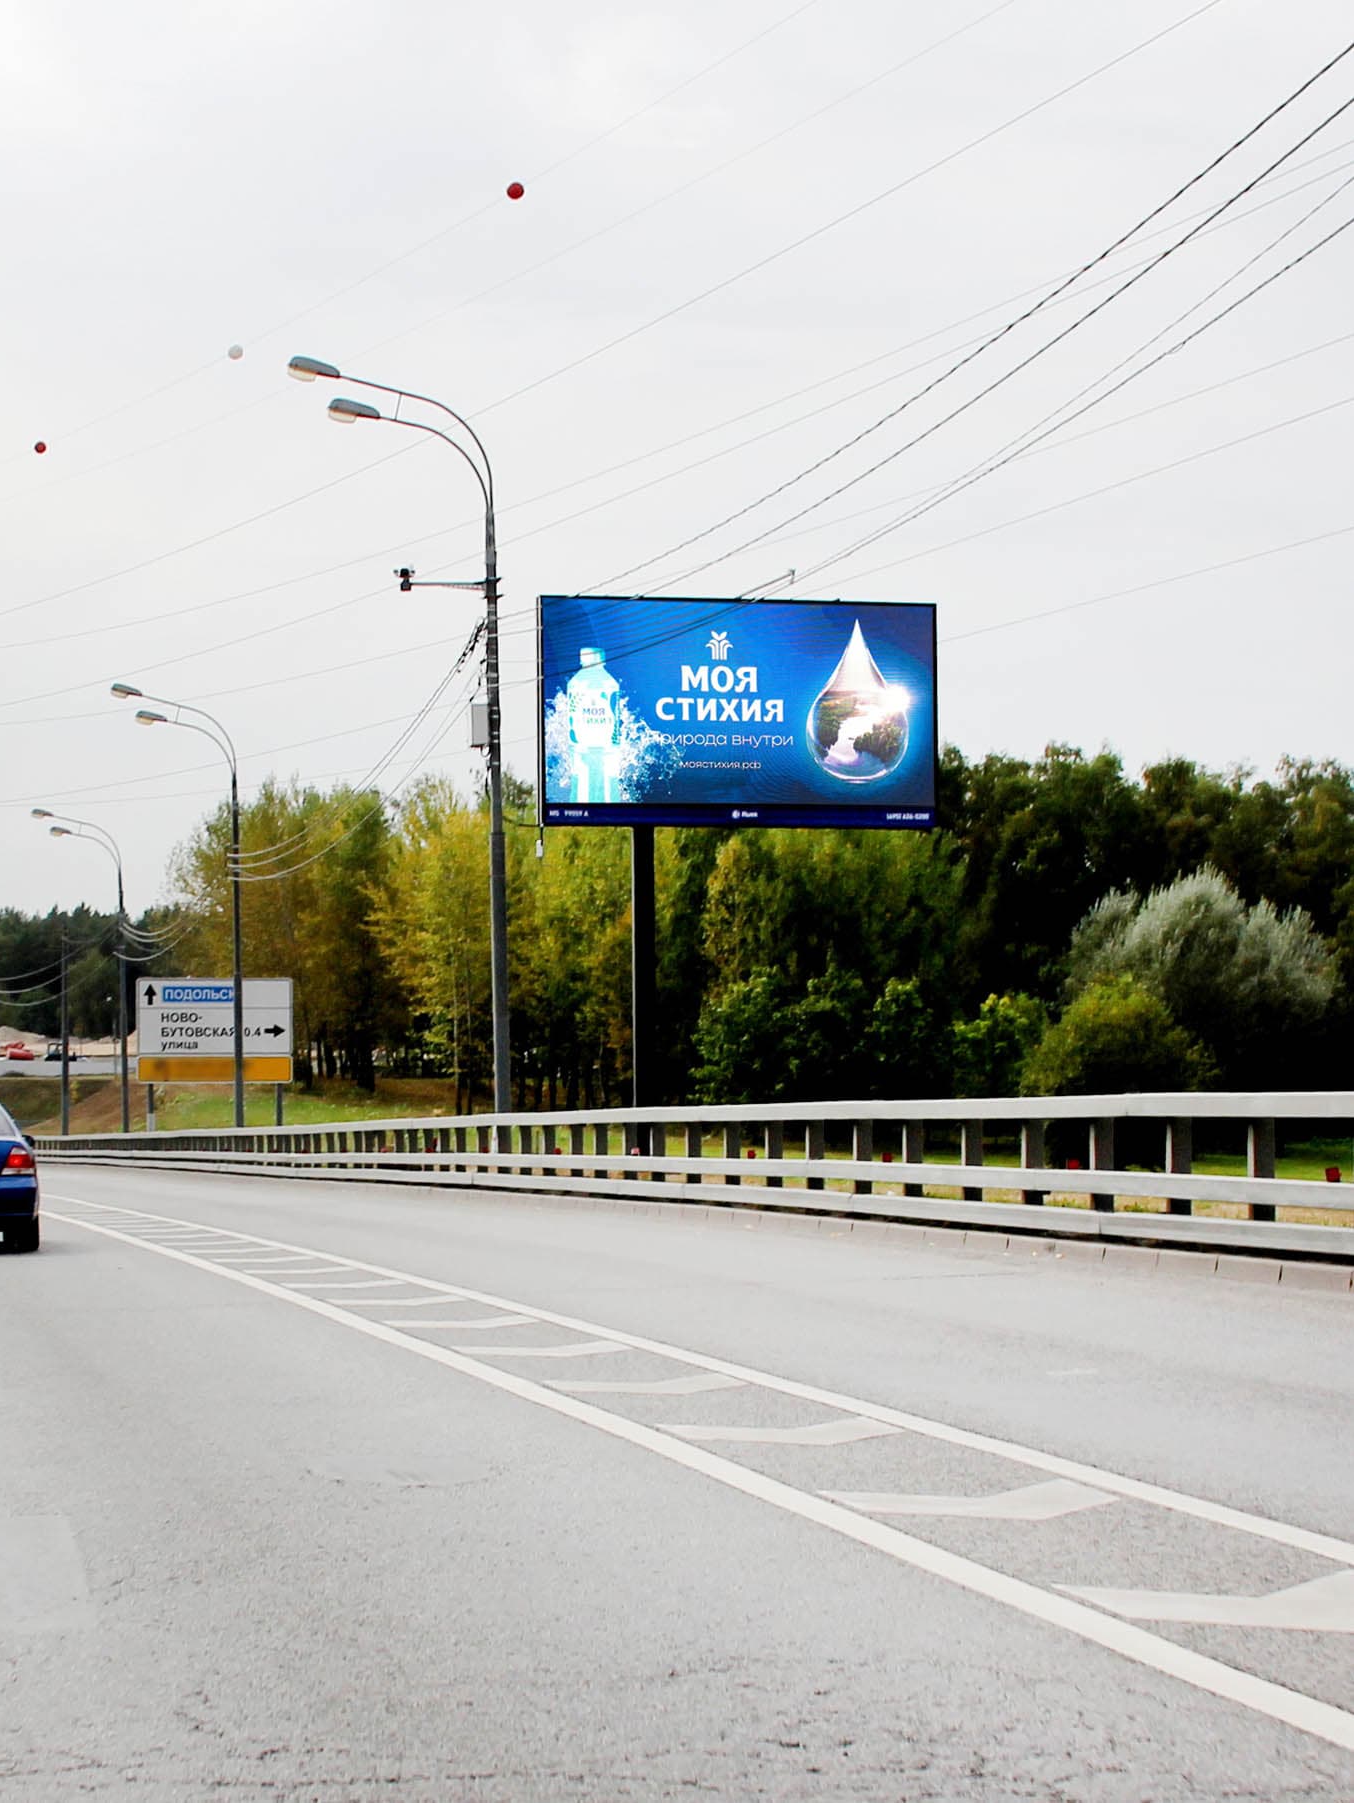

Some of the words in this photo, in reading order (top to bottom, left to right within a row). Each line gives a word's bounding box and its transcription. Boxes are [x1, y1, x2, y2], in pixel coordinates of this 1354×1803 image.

[680, 665, 758, 693] МОЯ
[655, 697, 784, 722] СТИХИЯ
[732, 734, 795, 748] внутри
[161, 1011, 203, 1023] НОВО-
[161, 1026, 235, 1038] БУТОВСКАЯ
[161, 1041, 199, 1051] улица
